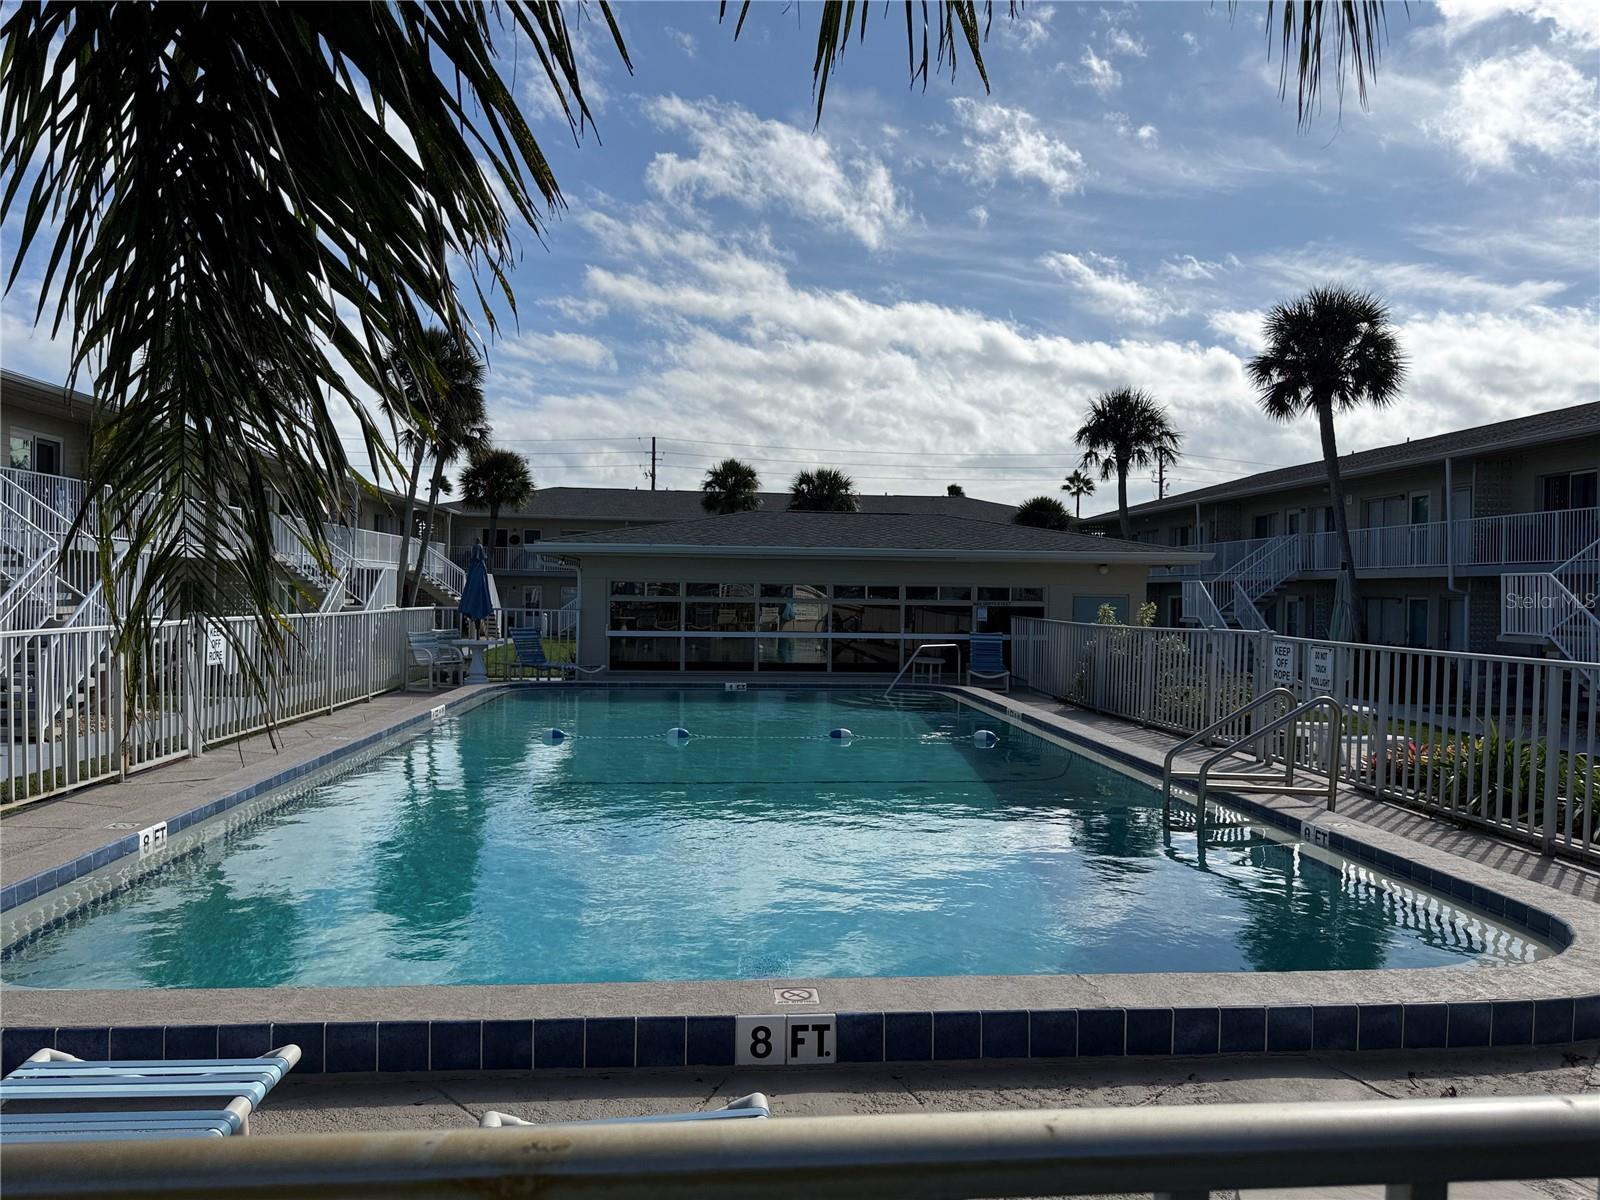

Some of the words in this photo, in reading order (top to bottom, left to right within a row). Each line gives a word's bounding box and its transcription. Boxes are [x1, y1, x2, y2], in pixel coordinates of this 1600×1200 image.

[1274, 646, 1291, 656] KEEP
[1276, 658, 1288, 668] OFF
[1274, 669, 1290, 680] ROPE
[750, 1025, 772, 1059] 8
[791, 1024, 831, 1058] FT.
